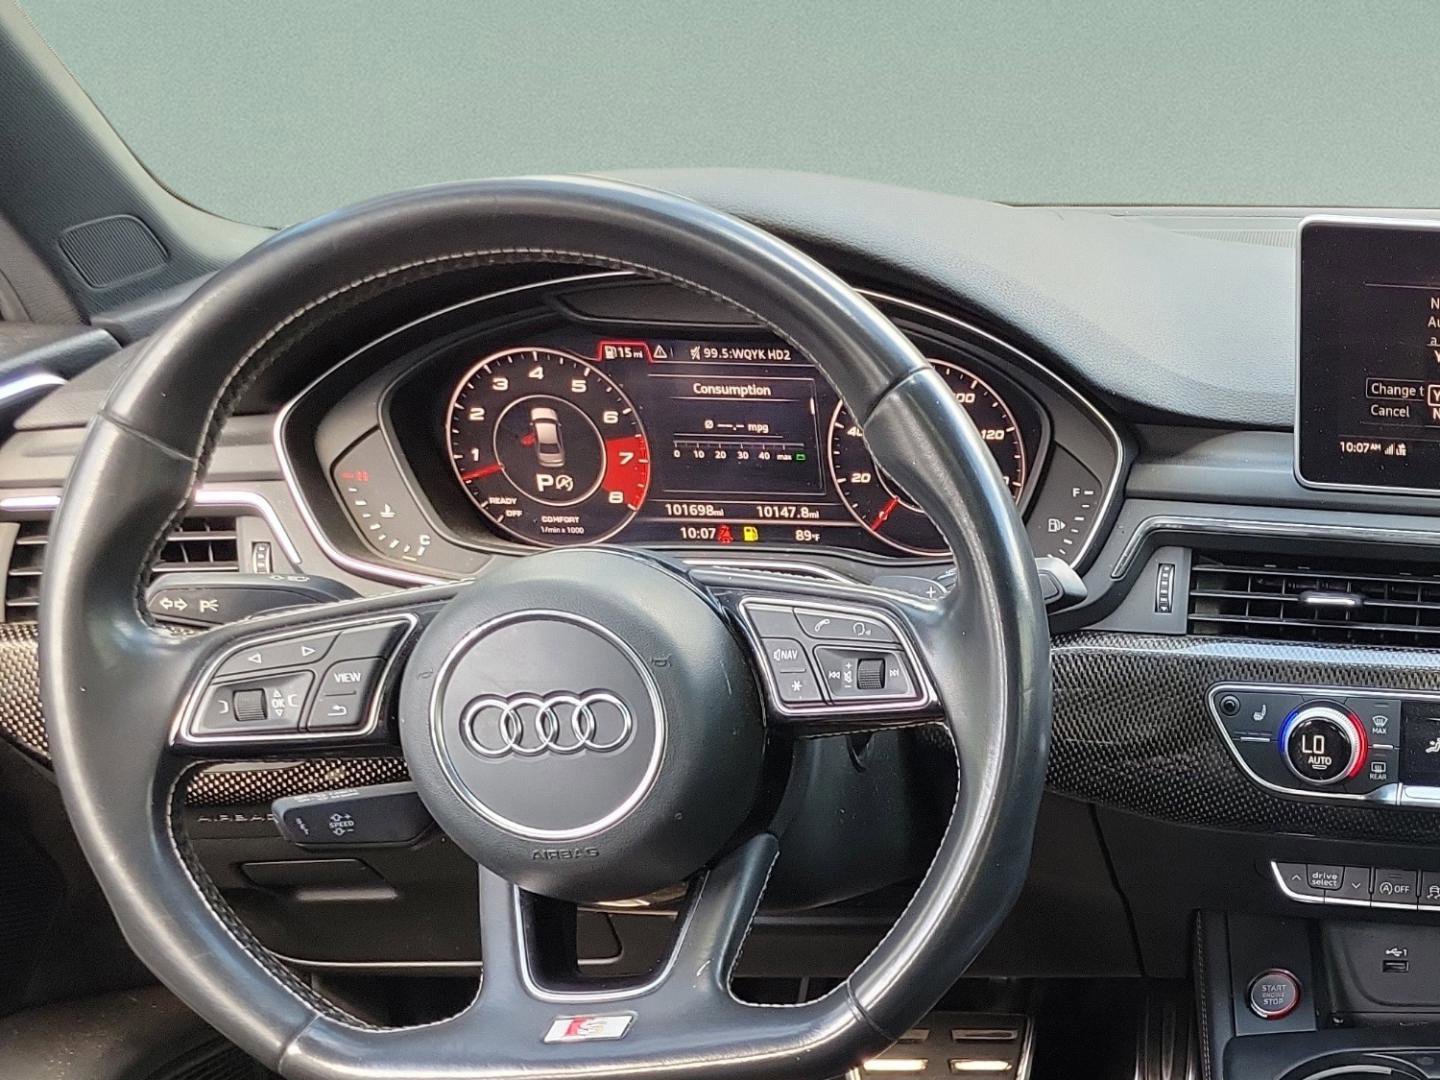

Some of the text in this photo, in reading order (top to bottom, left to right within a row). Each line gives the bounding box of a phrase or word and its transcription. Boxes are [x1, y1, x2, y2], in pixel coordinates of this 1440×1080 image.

[1430, 336, 1438, 346] a
[618, 345, 632, 358] 15
[704, 347, 791, 361] 99.5:WQYK HD2
[528, 366, 543, 379] 4
[492, 378, 508, 391] 3
[571, 379, 586, 392] 5
[693, 383, 771, 396] Consumption
[1371, 382, 1416, 398] Change
[469, 407, 485, 421] 2
[1370, 404, 1410, 418] Cancel
[603, 410, 619, 424] 6
[747, 423, 769, 433] mpg
[472, 448, 480, 461] 1
[618, 452, 634, 464] 7
[674, 451, 681, 459] 0
[693, 451, 704, 459] 10
[715, 451, 727, 460] 20
[737, 452, 749, 460] 30
[758, 452, 770, 460] 40
[536, 474, 554, 492] P
[851, 473, 872, 483] 20
[608, 491, 624, 504] 8
[1072, 488, 1080, 497] F
[488, 497, 517, 506] READY
[680, 526, 716, 539] 10:07
[420, 535, 431, 546] C
[780, 649, 798, 660] NAV
[334, 672, 361, 683] VIEW
[1308, 755, 1332, 765] AUTO
[1312, 872, 1338, 880] drive
[1311, 879, 1338, 887] select
[1394, 885, 1410, 894] OFF
[1261, 984, 1287, 992] START
[1263, 998, 1285, 1006] STOP
